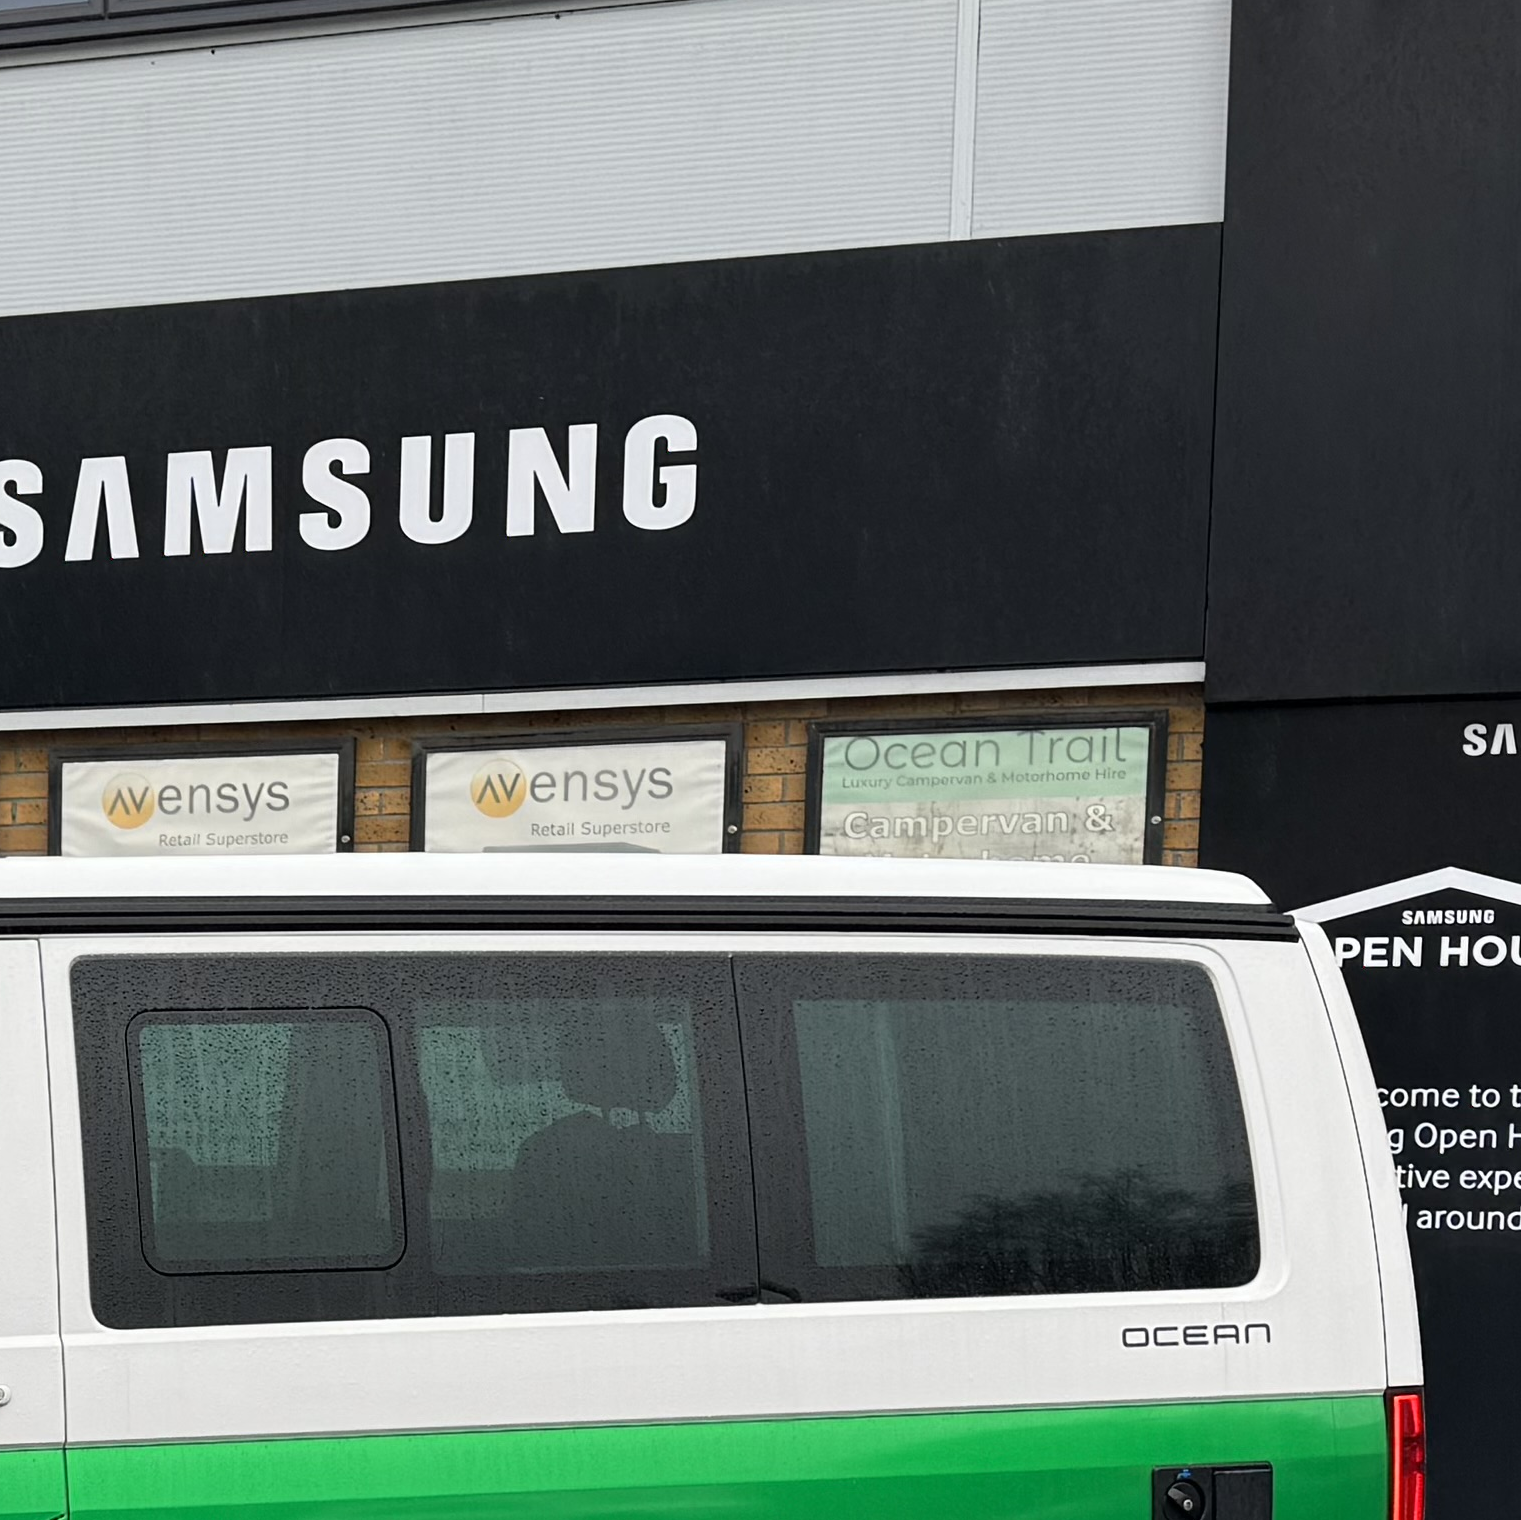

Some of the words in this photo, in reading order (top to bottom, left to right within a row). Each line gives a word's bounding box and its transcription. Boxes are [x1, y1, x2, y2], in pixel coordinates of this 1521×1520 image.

[845, 736, 1000, 771] Ocean
[1016, 727, 1127, 765] Trail
[1462, 723, 1517, 757] SA
[475, 766, 674, 811] Avensys
[842, 777, 891, 790] Luxury
[896, 774, 983, 788] Campervan
[987, 771, 998, 783] &
[1001, 769, 1091, 783] Motorhome
[1095, 766, 1127, 780] Hire
[107, 780, 291, 823] Avensys
[159, 833, 201, 847] Retail
[206, 831, 289, 848] Superstore
[531, 822, 575, 837] Retail
[581, 820, 671, 838] Superstore
[843, 811, 1069, 844] Campervan
[1085, 803, 1115, 832] &
[1401, 909, 1496, 926] SAMSUNG
[1335, 936, 1423, 968] PEN
[1469, 1084, 1501, 1108] to
[1414, 1122, 1497, 1155] Open
[1122, 1323, 1271, 1348] OCEAN
